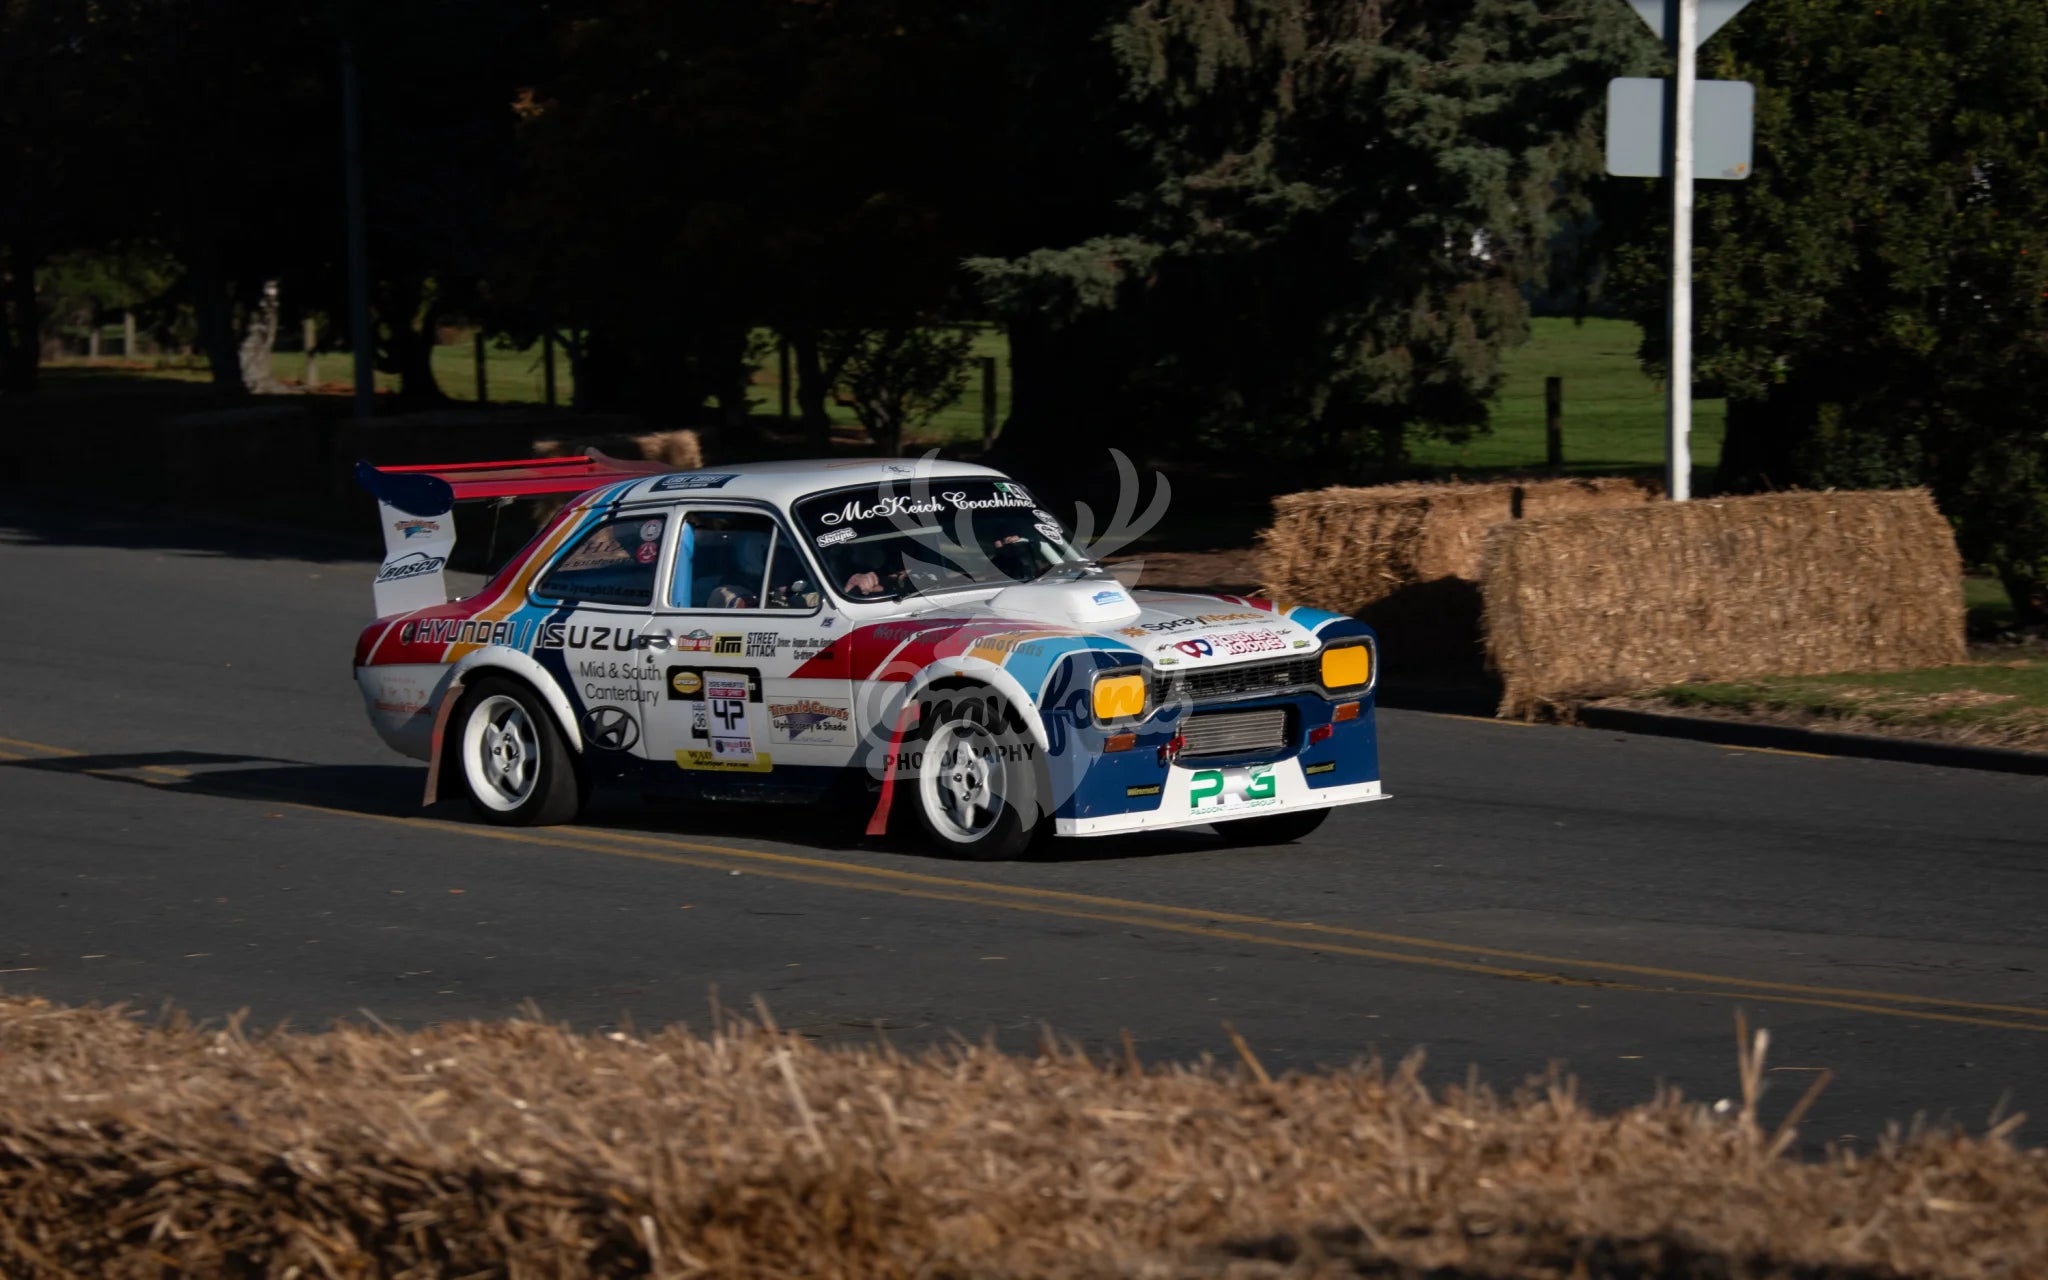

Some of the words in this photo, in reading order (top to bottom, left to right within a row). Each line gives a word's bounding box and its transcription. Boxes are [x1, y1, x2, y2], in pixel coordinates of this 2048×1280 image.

[821, 495, 945, 525] McKeich
[415, 619, 516, 646] HYUNDAI
[535, 622, 635, 652] ISUZU
[746, 632, 778, 645] STREET
[745, 645, 776, 657] ATTACK
[580, 661, 605, 678] Mid
[609, 662, 619, 679] &
[622, 663, 660, 681] South
[585, 683, 660, 707] Canterbury
[767, 699, 811, 718] Tinwald
[811, 701, 849, 721] Canvas
[773, 719, 815, 733] Upholstery
[822, 721, 848, 731] Shade
[1190, 766, 1276, 808] PRG
